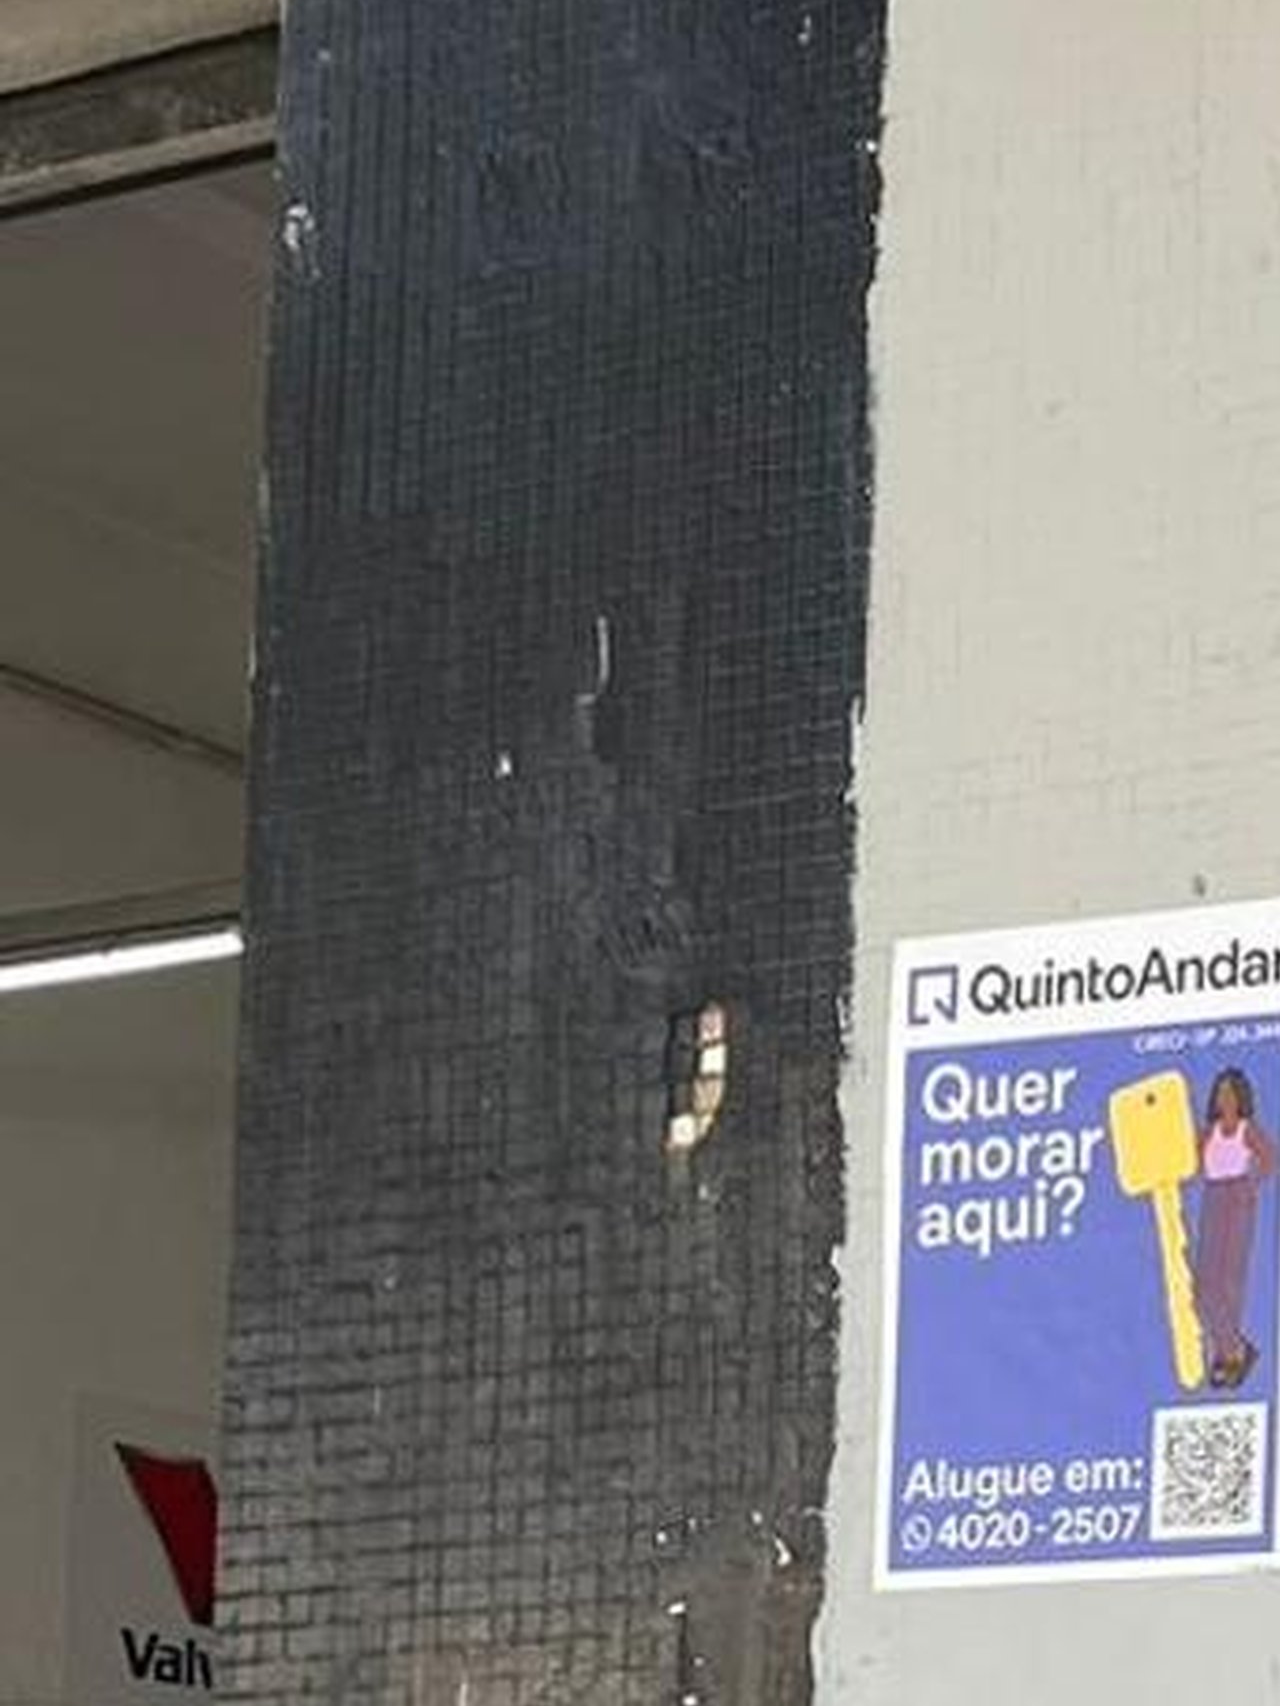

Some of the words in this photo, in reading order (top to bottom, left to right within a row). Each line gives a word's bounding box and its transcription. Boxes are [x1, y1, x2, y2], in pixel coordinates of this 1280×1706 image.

[920, 1062, 1077, 1123] Quer
[919, 1126, 1104, 1185] morar
[916, 1177, 1085, 1257] aqui?
[902, 1458, 1054, 1510] Alugue
[1064, 1456, 1144, 1494] em:
